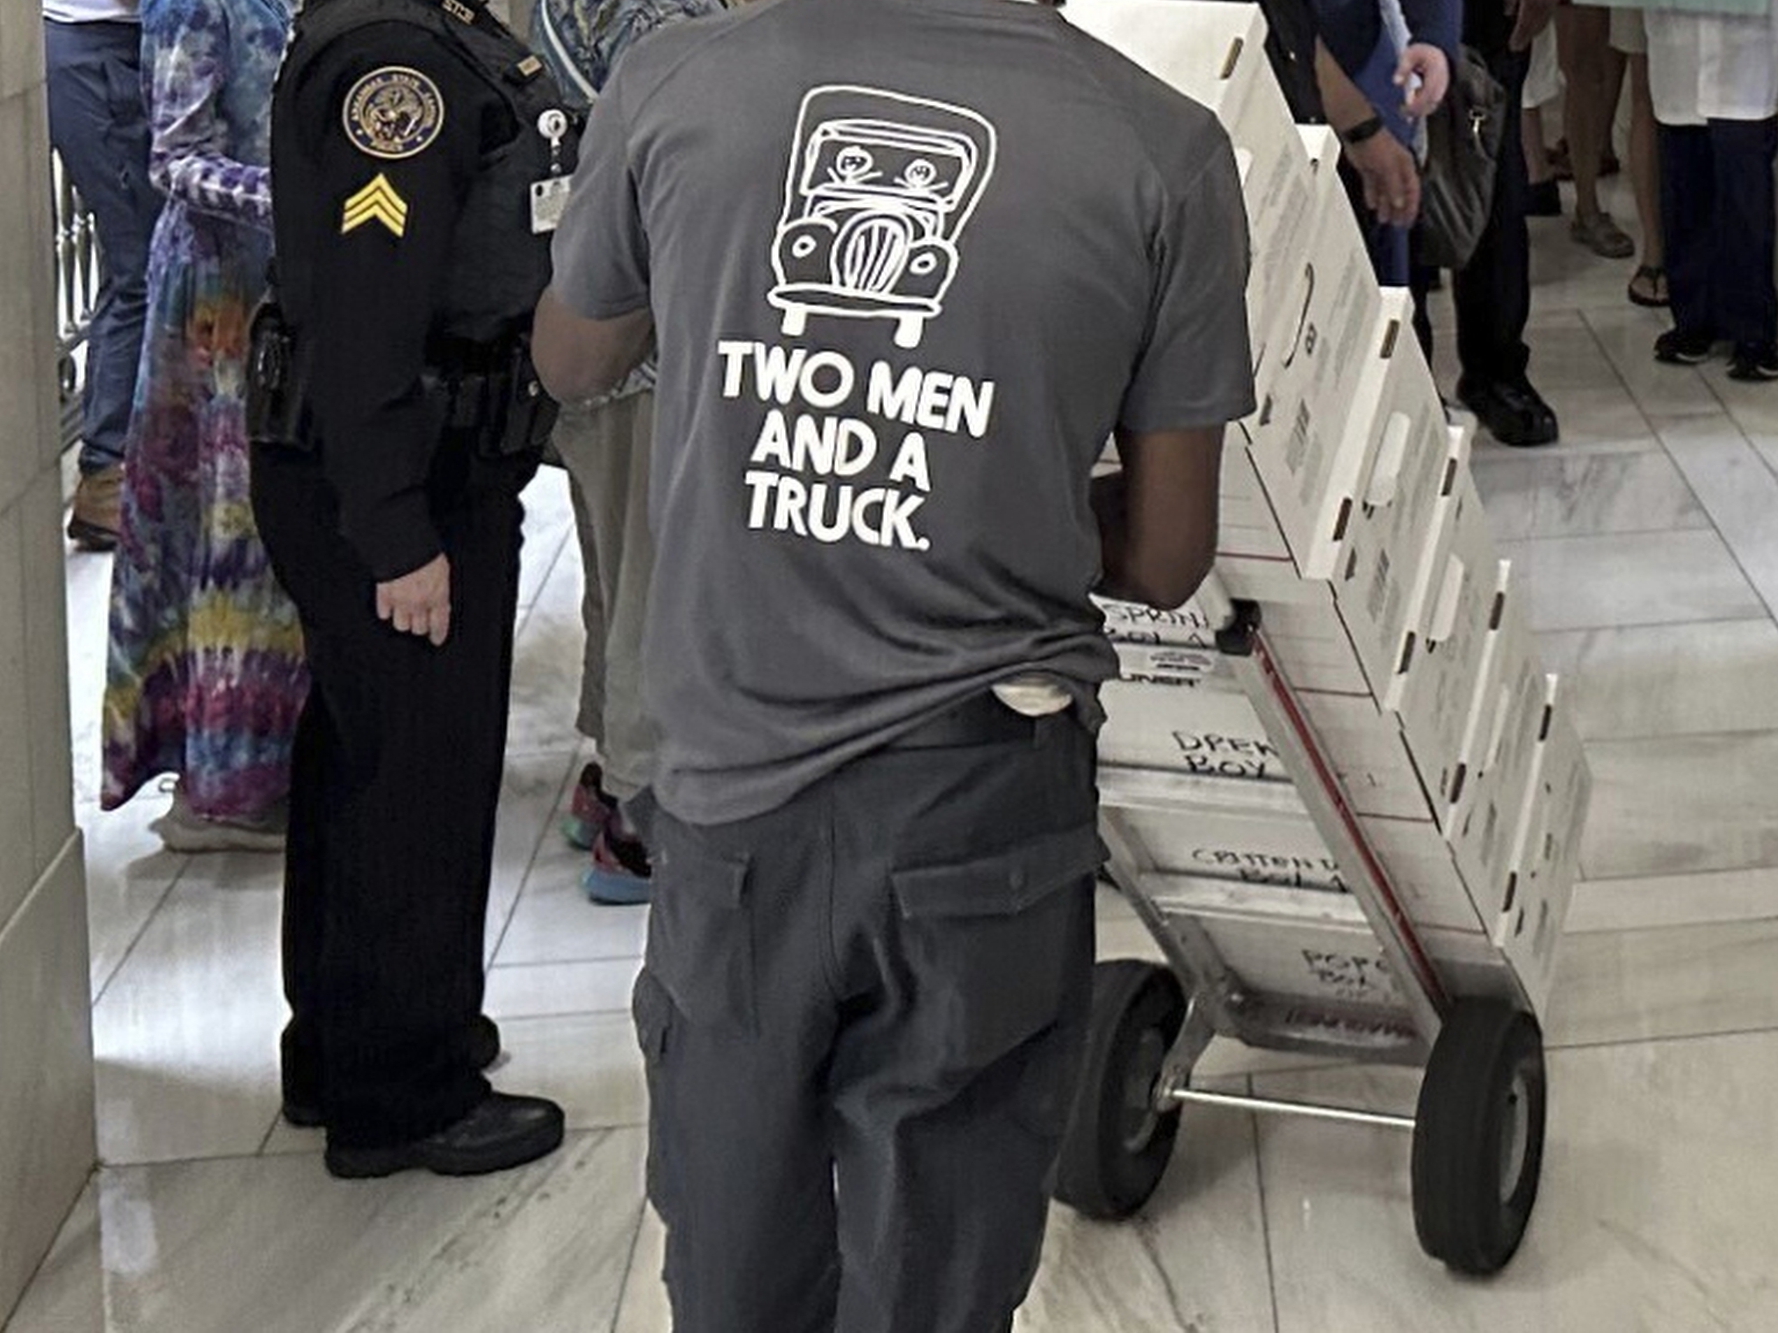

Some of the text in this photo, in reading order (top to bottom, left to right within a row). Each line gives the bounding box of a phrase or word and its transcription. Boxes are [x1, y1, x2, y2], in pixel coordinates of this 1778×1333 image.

[718, 340, 995, 438] TWO MEN
[751, 409, 931, 492] AND A
[744, 470, 930, 551] TRUCK.
